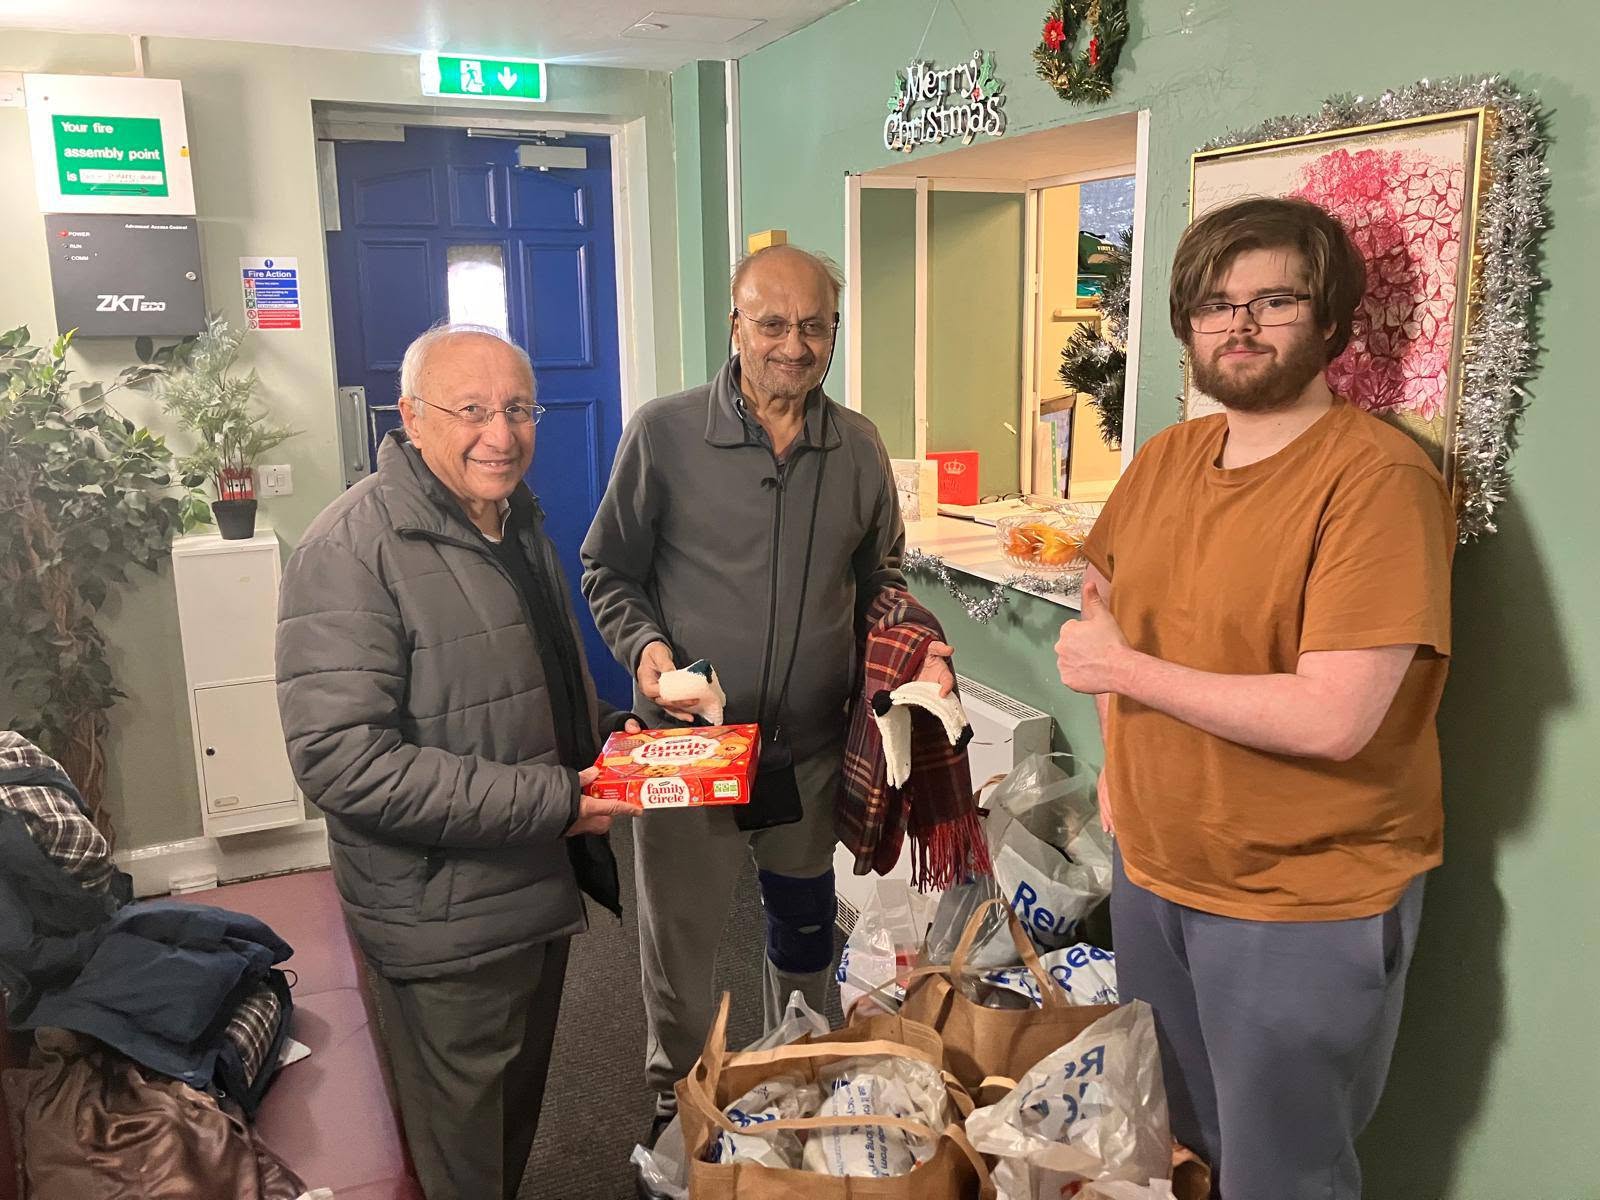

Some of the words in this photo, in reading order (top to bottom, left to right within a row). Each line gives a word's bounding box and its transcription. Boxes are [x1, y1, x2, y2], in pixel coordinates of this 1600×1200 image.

[904, 60, 978, 101] Merry
[61, 121, 88, 133] Your
[93, 122, 114, 134] fire
[884, 96, 1000, 150] Christmas
[64, 147, 124, 160] assembly
[129, 148, 160, 161] point
[66, 171, 77, 182] is
[643, 742, 710, 752] family
[647, 782, 685, 795] family
[648, 794, 684, 804] Circle
[1010, 880, 1078, 937] Reu
